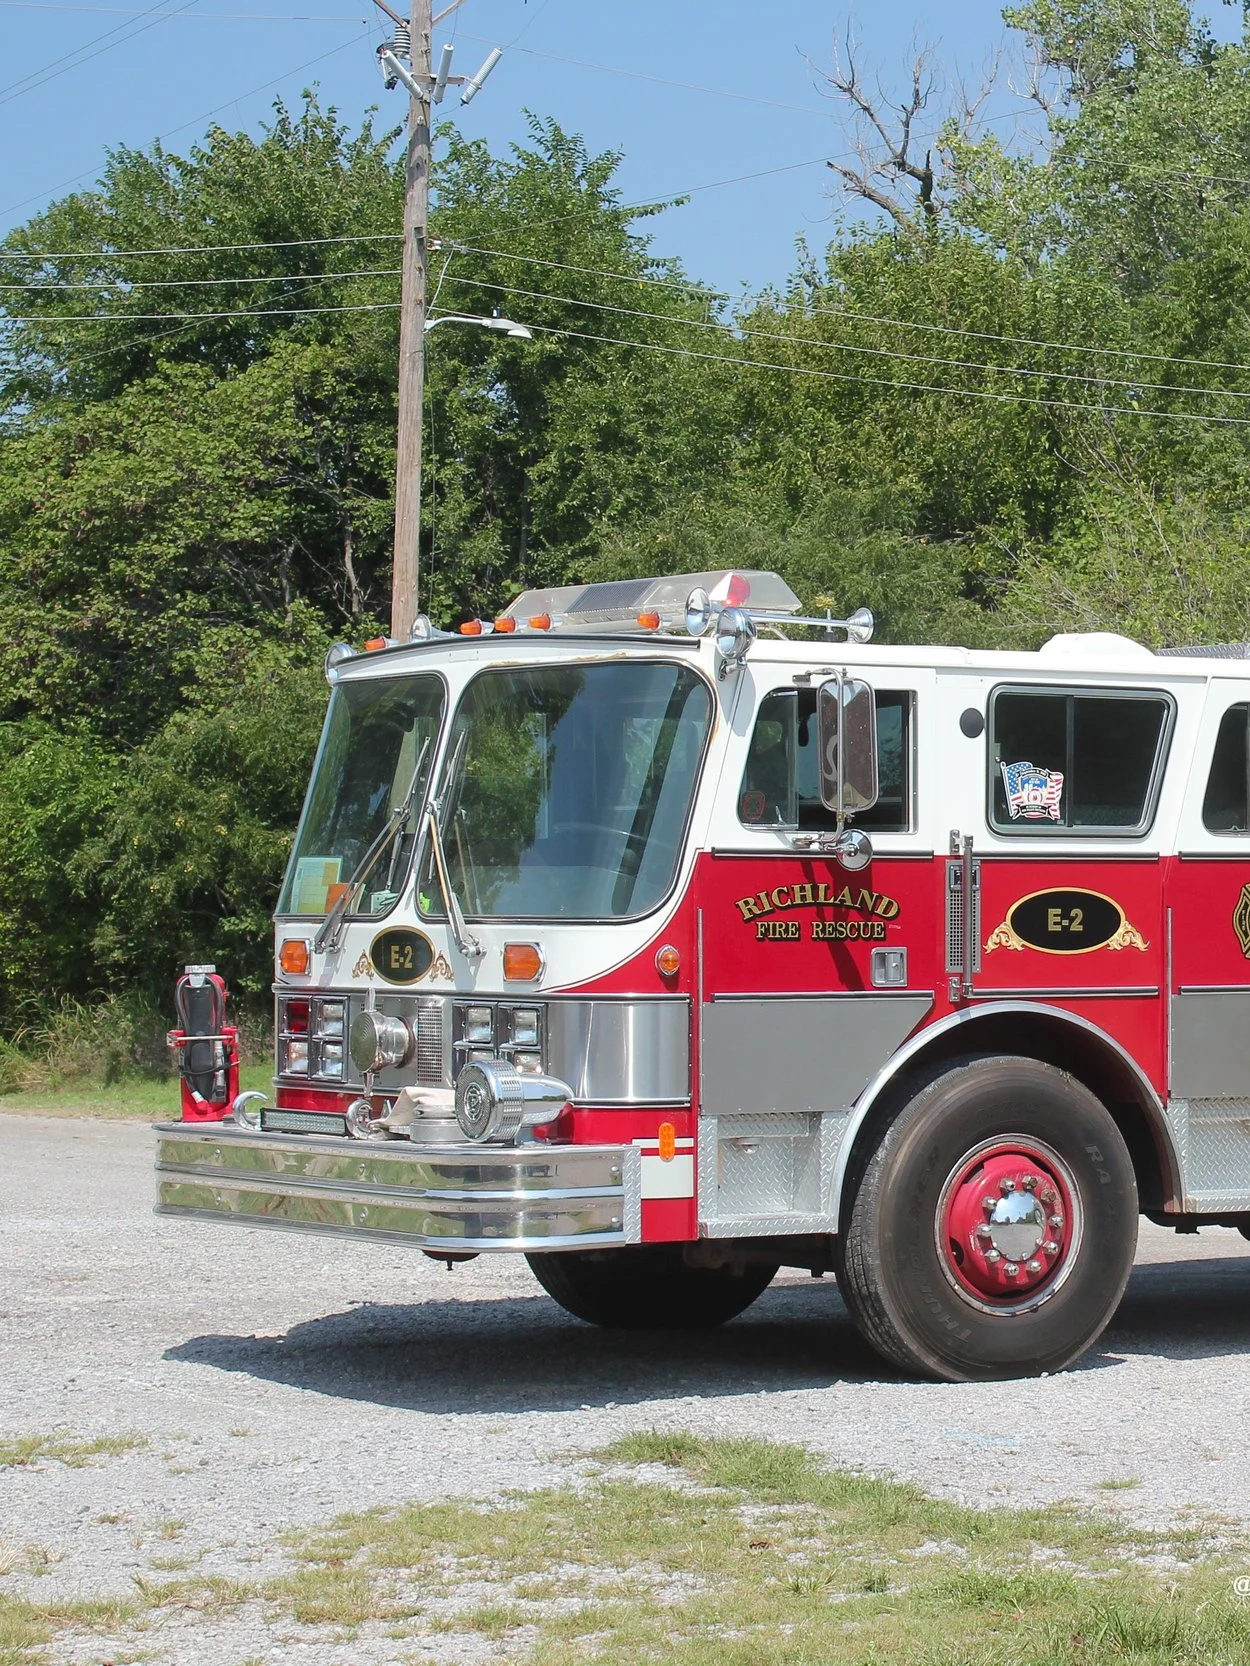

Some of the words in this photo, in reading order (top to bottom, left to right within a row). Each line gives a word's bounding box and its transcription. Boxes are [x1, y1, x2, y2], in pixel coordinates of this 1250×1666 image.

[735, 883, 900, 921] RICHLAND
[756, 921, 800, 940] FIRE
[811, 921, 886, 940] RESCUE
[1046, 908, 1084, 932] E-2
[390, 945, 413, 969] E-2
